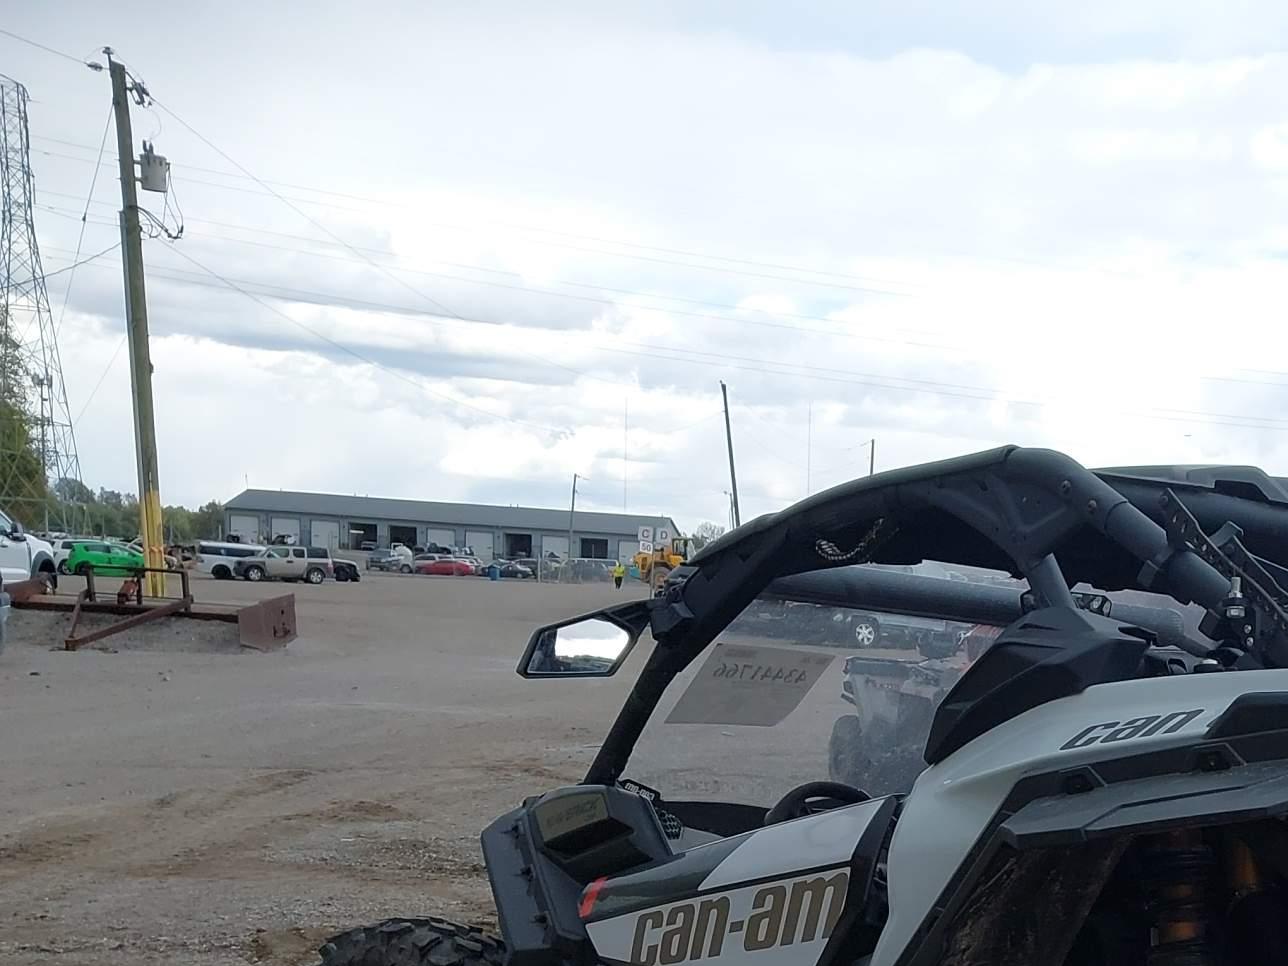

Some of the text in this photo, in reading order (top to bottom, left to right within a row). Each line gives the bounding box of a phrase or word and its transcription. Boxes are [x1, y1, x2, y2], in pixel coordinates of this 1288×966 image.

[642, 529, 650, 538] C
[660, 530, 668, 540] D
[1059, 708, 1206, 751] can
